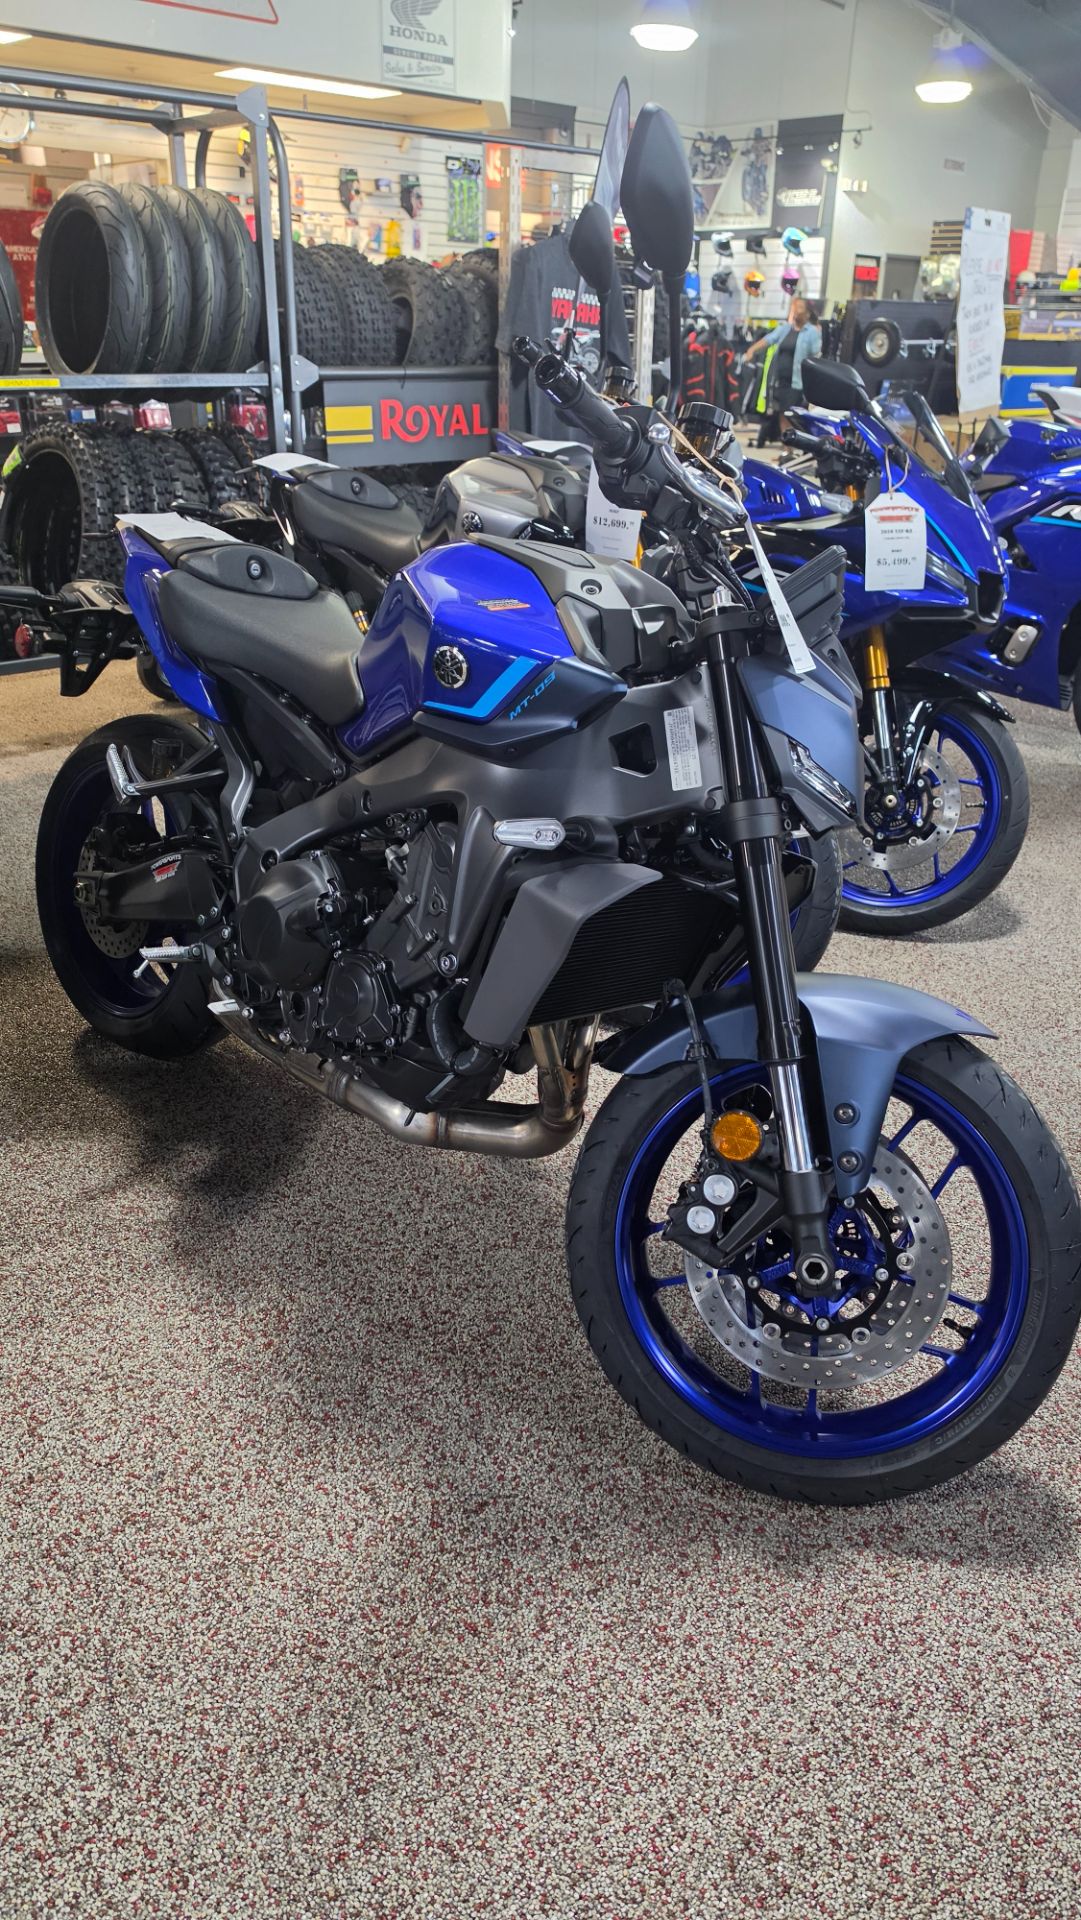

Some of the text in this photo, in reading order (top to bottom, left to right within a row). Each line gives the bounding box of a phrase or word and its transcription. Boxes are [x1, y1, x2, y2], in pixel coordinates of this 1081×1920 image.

[389, 25, 448, 46] HONDA
[379, 399, 488, 443] ROYAL
[509, 671, 556, 720] MT-09
